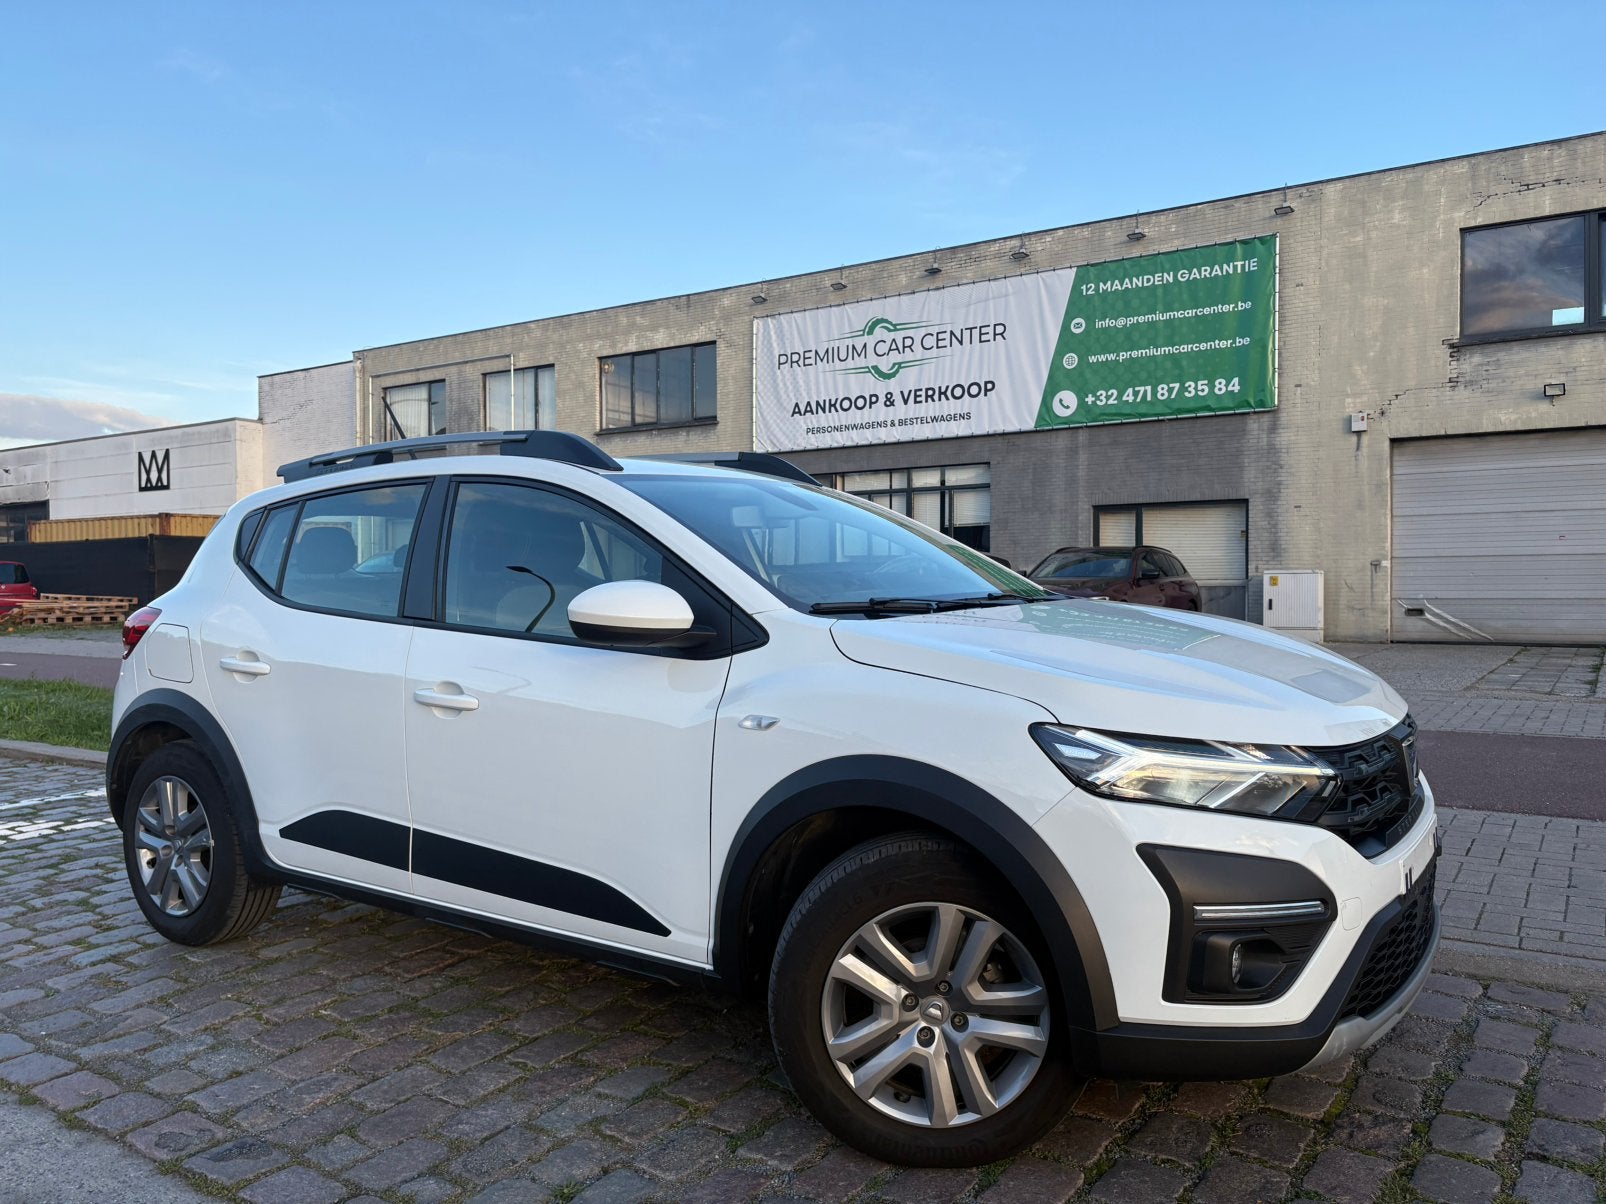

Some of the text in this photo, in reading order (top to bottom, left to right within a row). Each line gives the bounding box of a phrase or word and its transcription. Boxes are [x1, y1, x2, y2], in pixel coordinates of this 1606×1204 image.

[1081, 258, 1258, 296] 12 MAANDEN GARANTIE
[1095, 300, 1252, 329] info@premiumcarcenter.be
[777, 323, 1007, 370] PREMIUM CAR CENTER
[1088, 336, 1251, 363] www.premiumcarcenter.be
[791, 380, 996, 417] AANKOOP & VERKOOP
[1085, 377, 1240, 406] +32 471 87 35 84
[806, 412, 972, 435] PERSONENWAGENS & BESTELWAGENS
